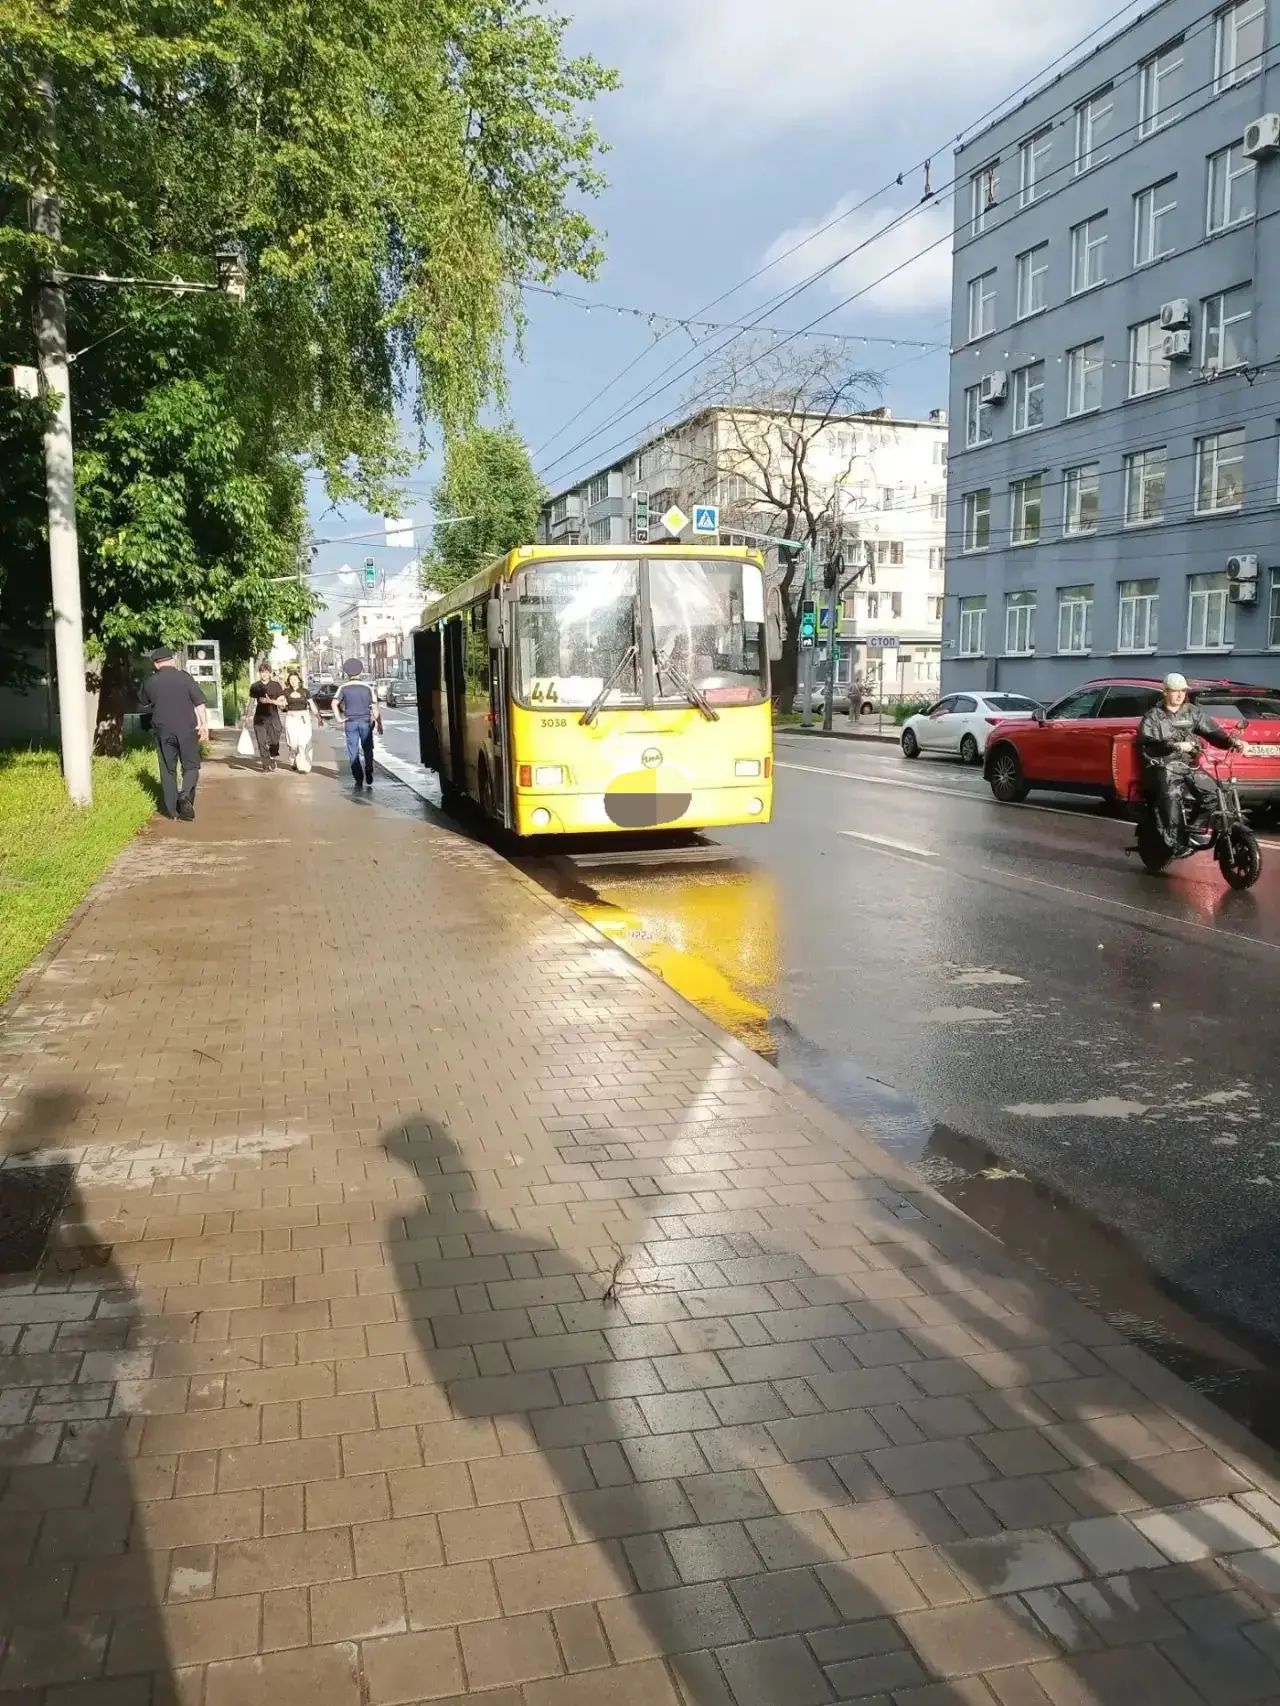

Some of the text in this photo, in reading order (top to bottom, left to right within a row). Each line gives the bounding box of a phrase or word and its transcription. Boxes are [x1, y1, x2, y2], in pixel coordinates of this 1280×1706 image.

[870, 637, 895, 646] СТОП
[531, 681, 559, 703] 44
[540, 718, 567, 728] 3038
